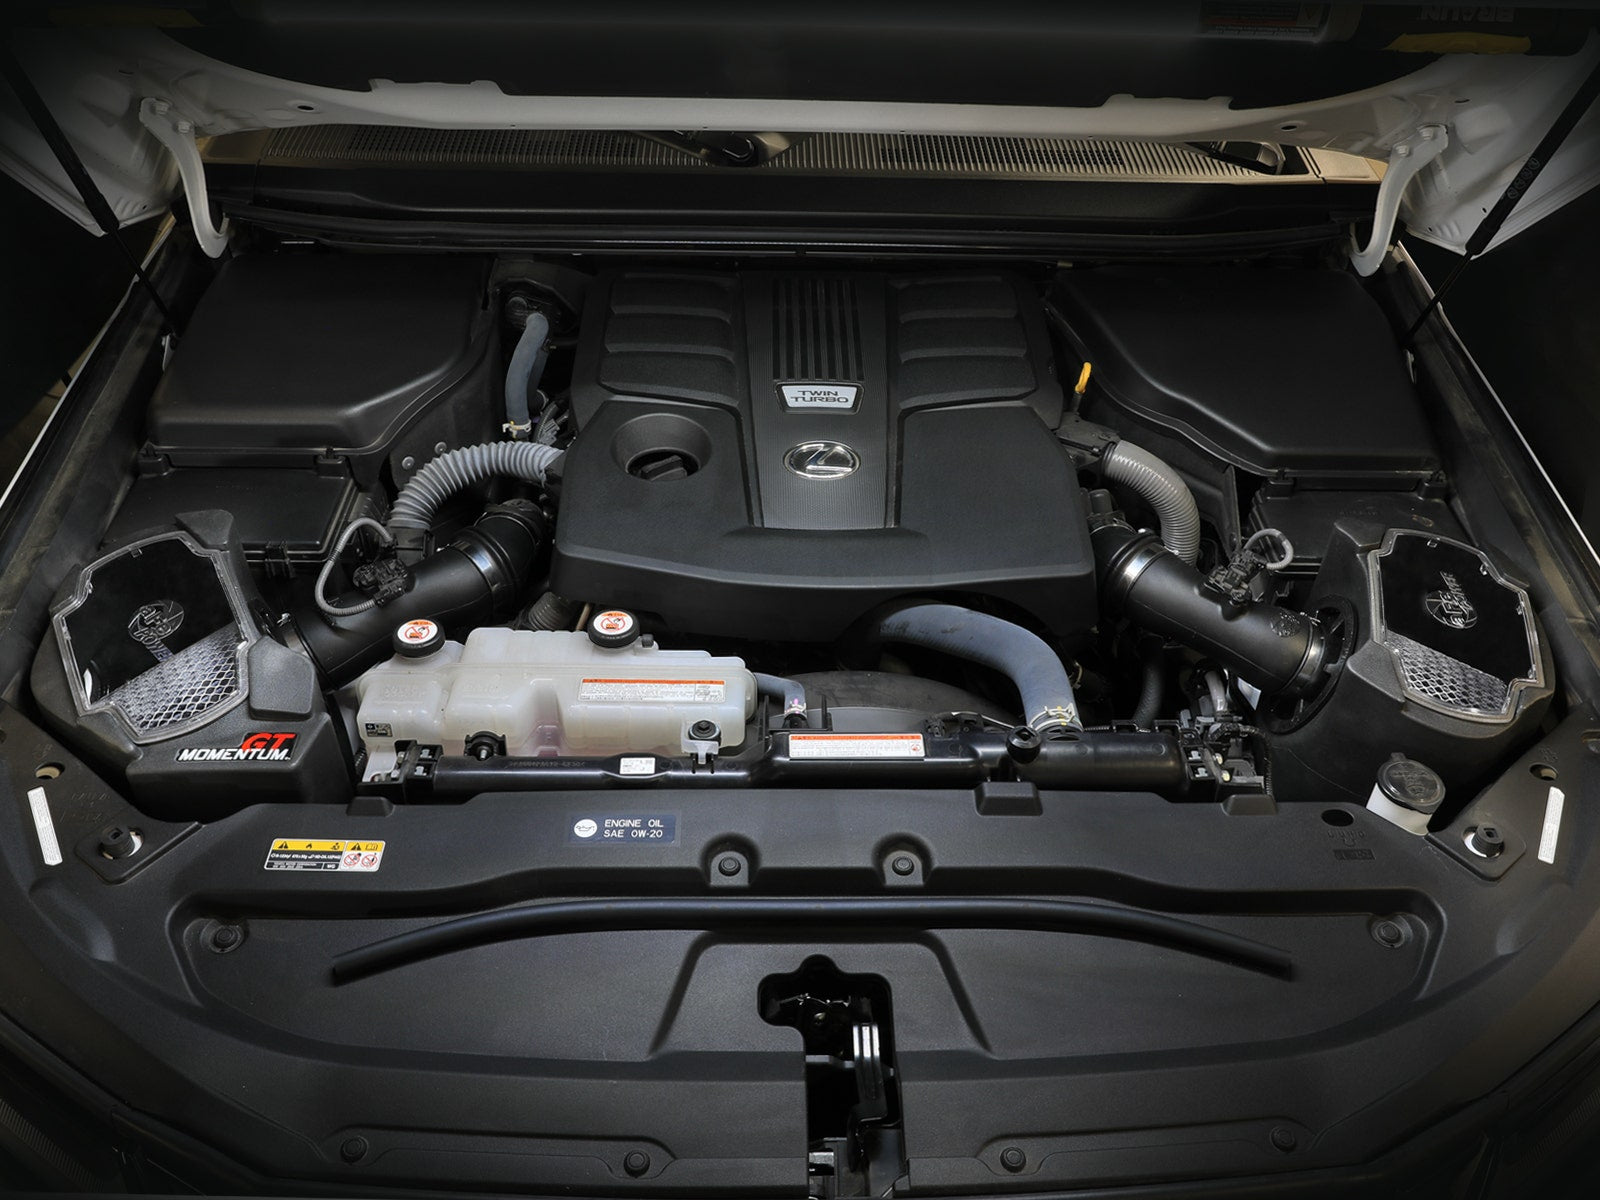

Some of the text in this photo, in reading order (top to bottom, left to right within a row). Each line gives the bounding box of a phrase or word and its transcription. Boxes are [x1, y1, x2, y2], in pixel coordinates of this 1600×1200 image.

[790, 396, 849, 404] TURBO
[241, 732, 297, 753] GT
[177, 748, 289, 761] MOMENTUM
[604, 819, 664, 828] ENGINE OIL
[603, 829, 624, 838] SAE
